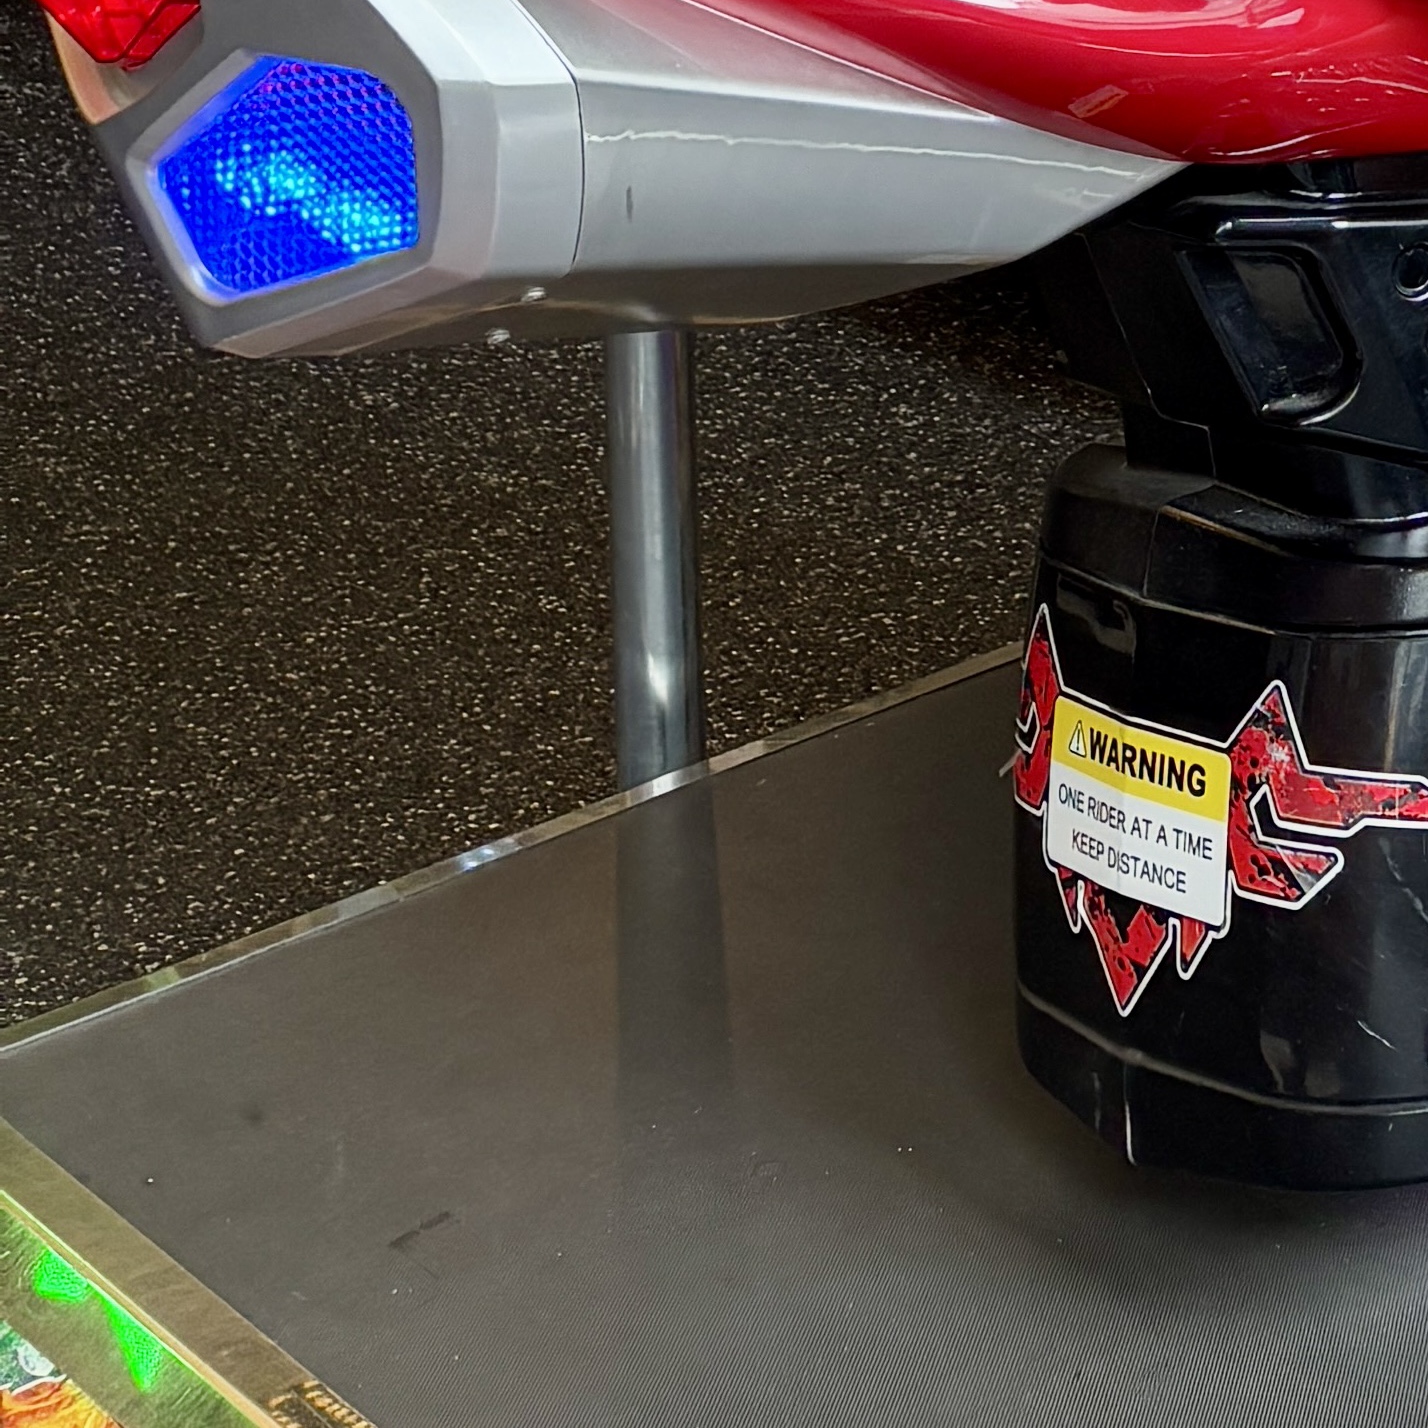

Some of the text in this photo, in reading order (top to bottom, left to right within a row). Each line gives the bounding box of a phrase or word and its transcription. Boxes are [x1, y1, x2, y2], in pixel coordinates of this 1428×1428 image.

[1089, 727, 1207, 797] WARNING
[1058, 783, 1213, 860] ONE RIDER AT A TIME
[1072, 828, 1187, 894] KEEP DISTANCE
